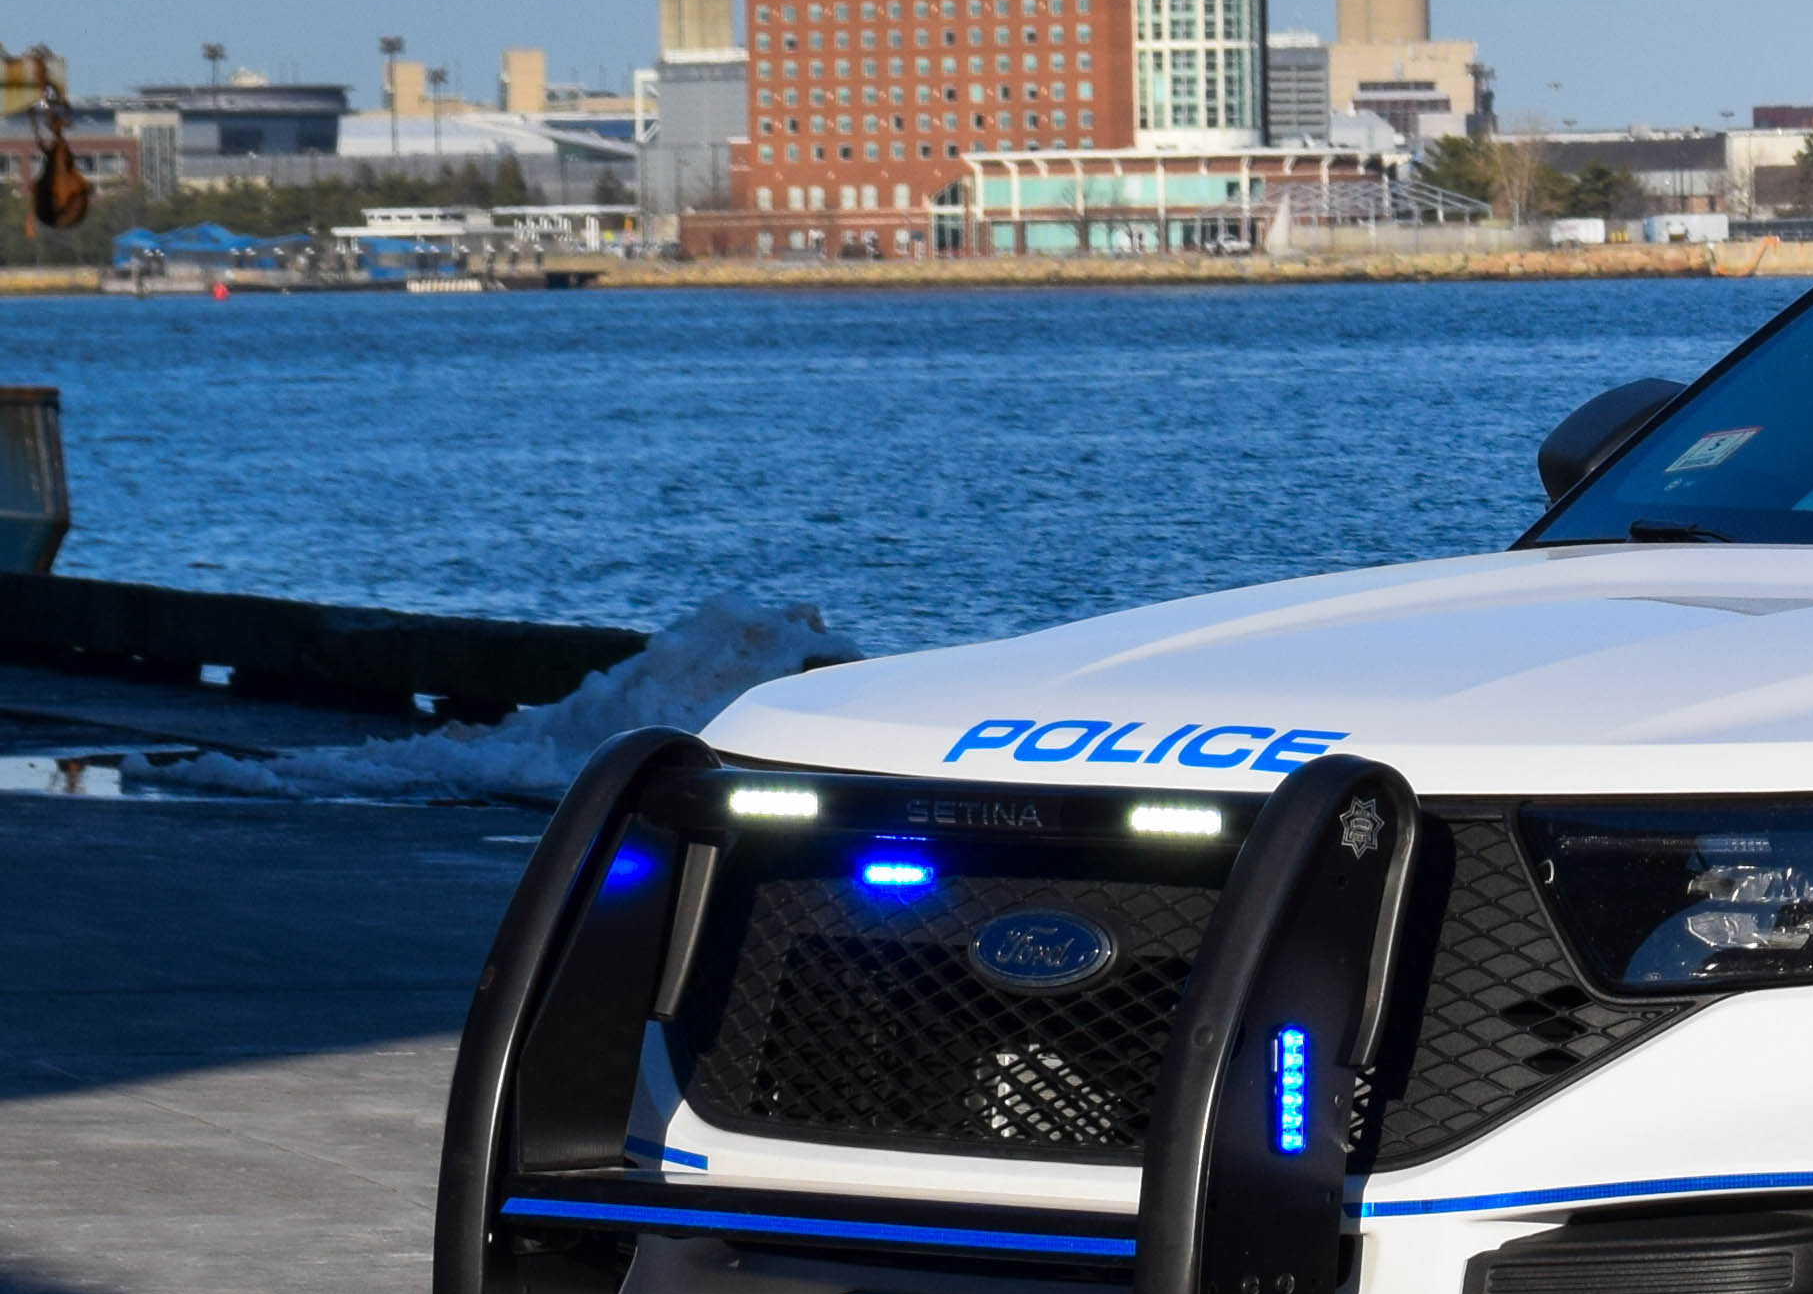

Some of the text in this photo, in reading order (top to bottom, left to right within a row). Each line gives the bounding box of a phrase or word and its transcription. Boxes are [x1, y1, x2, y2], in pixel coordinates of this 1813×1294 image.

[941, 718, 1353, 774] POLICE
[906, 799, 1043, 827] SETINA
[993, 925, 1076, 968] Ford
